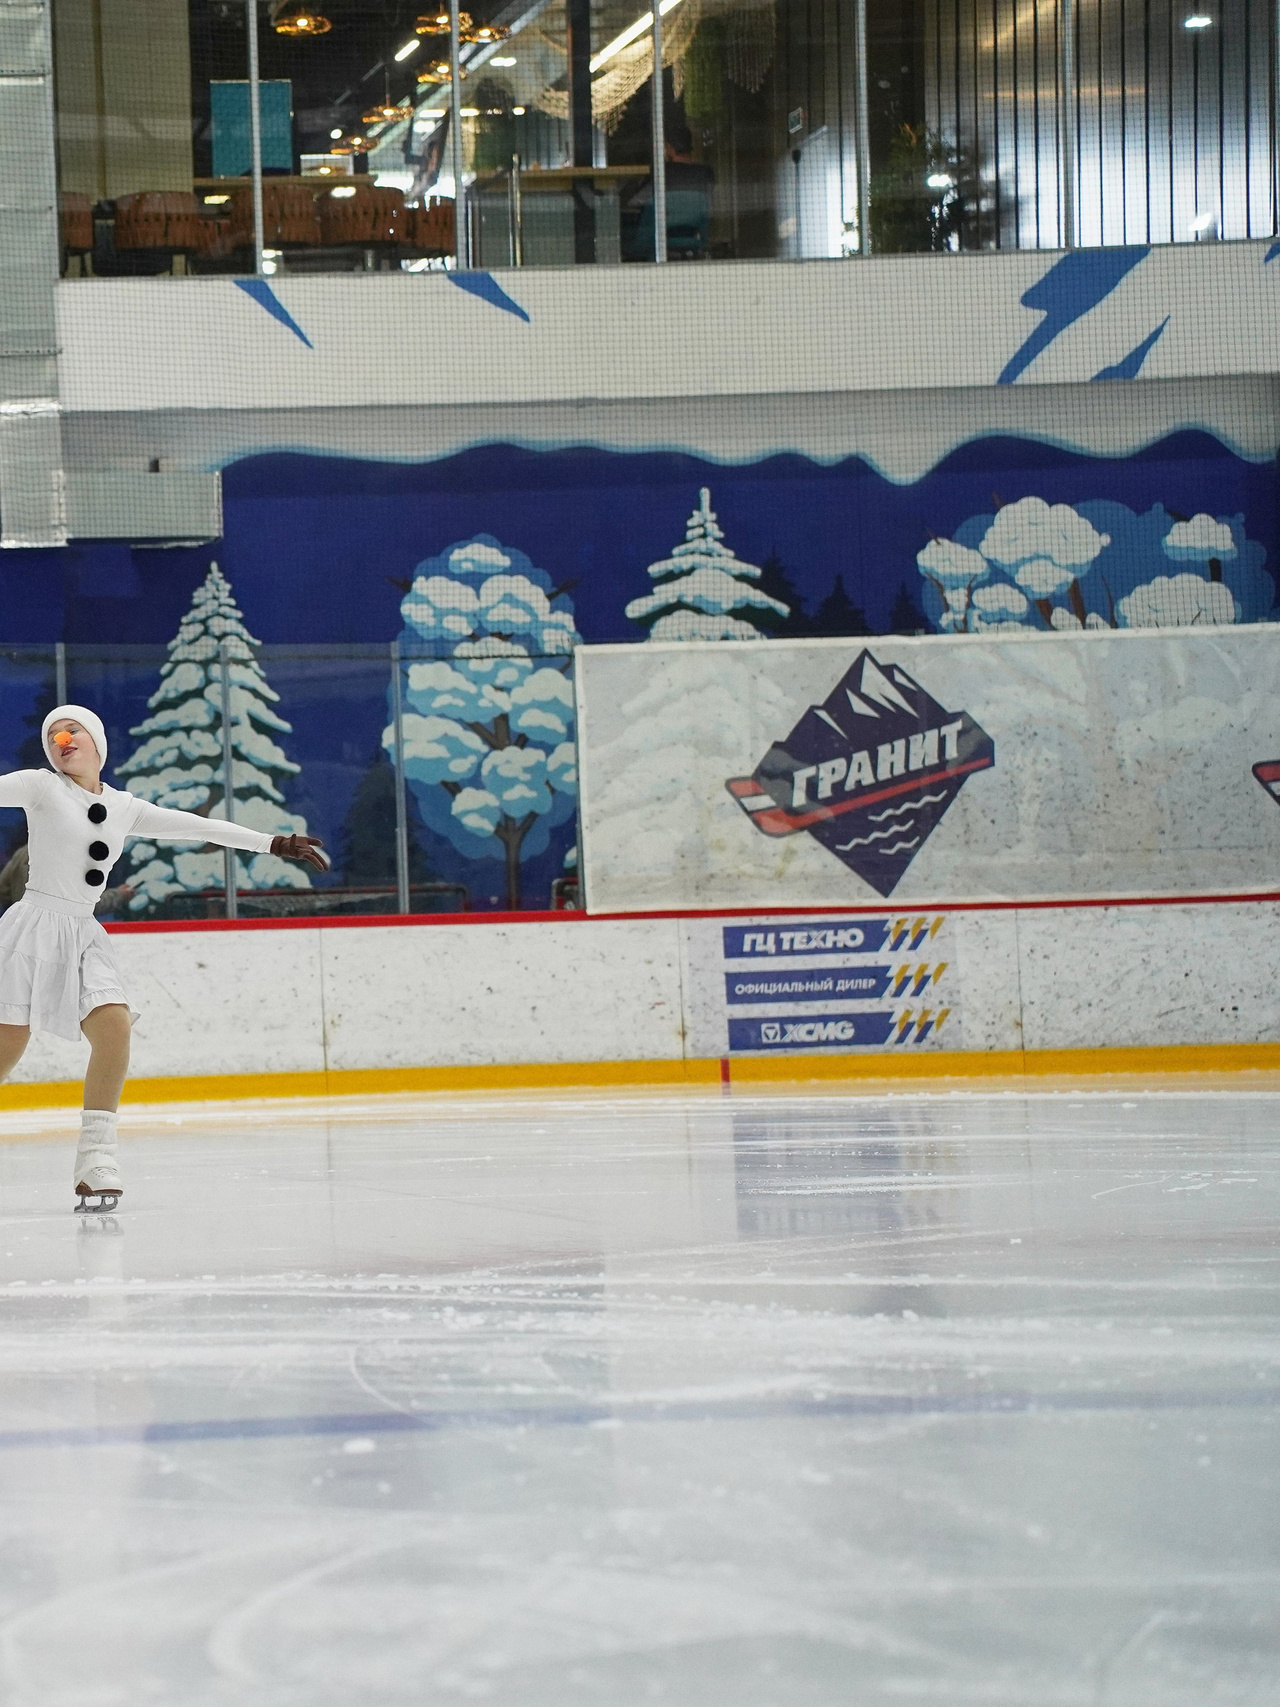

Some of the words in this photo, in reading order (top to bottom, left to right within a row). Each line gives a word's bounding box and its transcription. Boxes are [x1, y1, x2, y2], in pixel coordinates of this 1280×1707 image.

[791, 719, 964, 808] ГРАНИТ
[742, 932, 776, 954] ГЦ
[779, 927, 865, 951] ТЕХНО
[734, 978, 833, 995] ОФИЦИАЛЬНЫЙ
[835, 978, 877, 992] ДИЛЕР
[780, 1020, 855, 1042] XCMG
